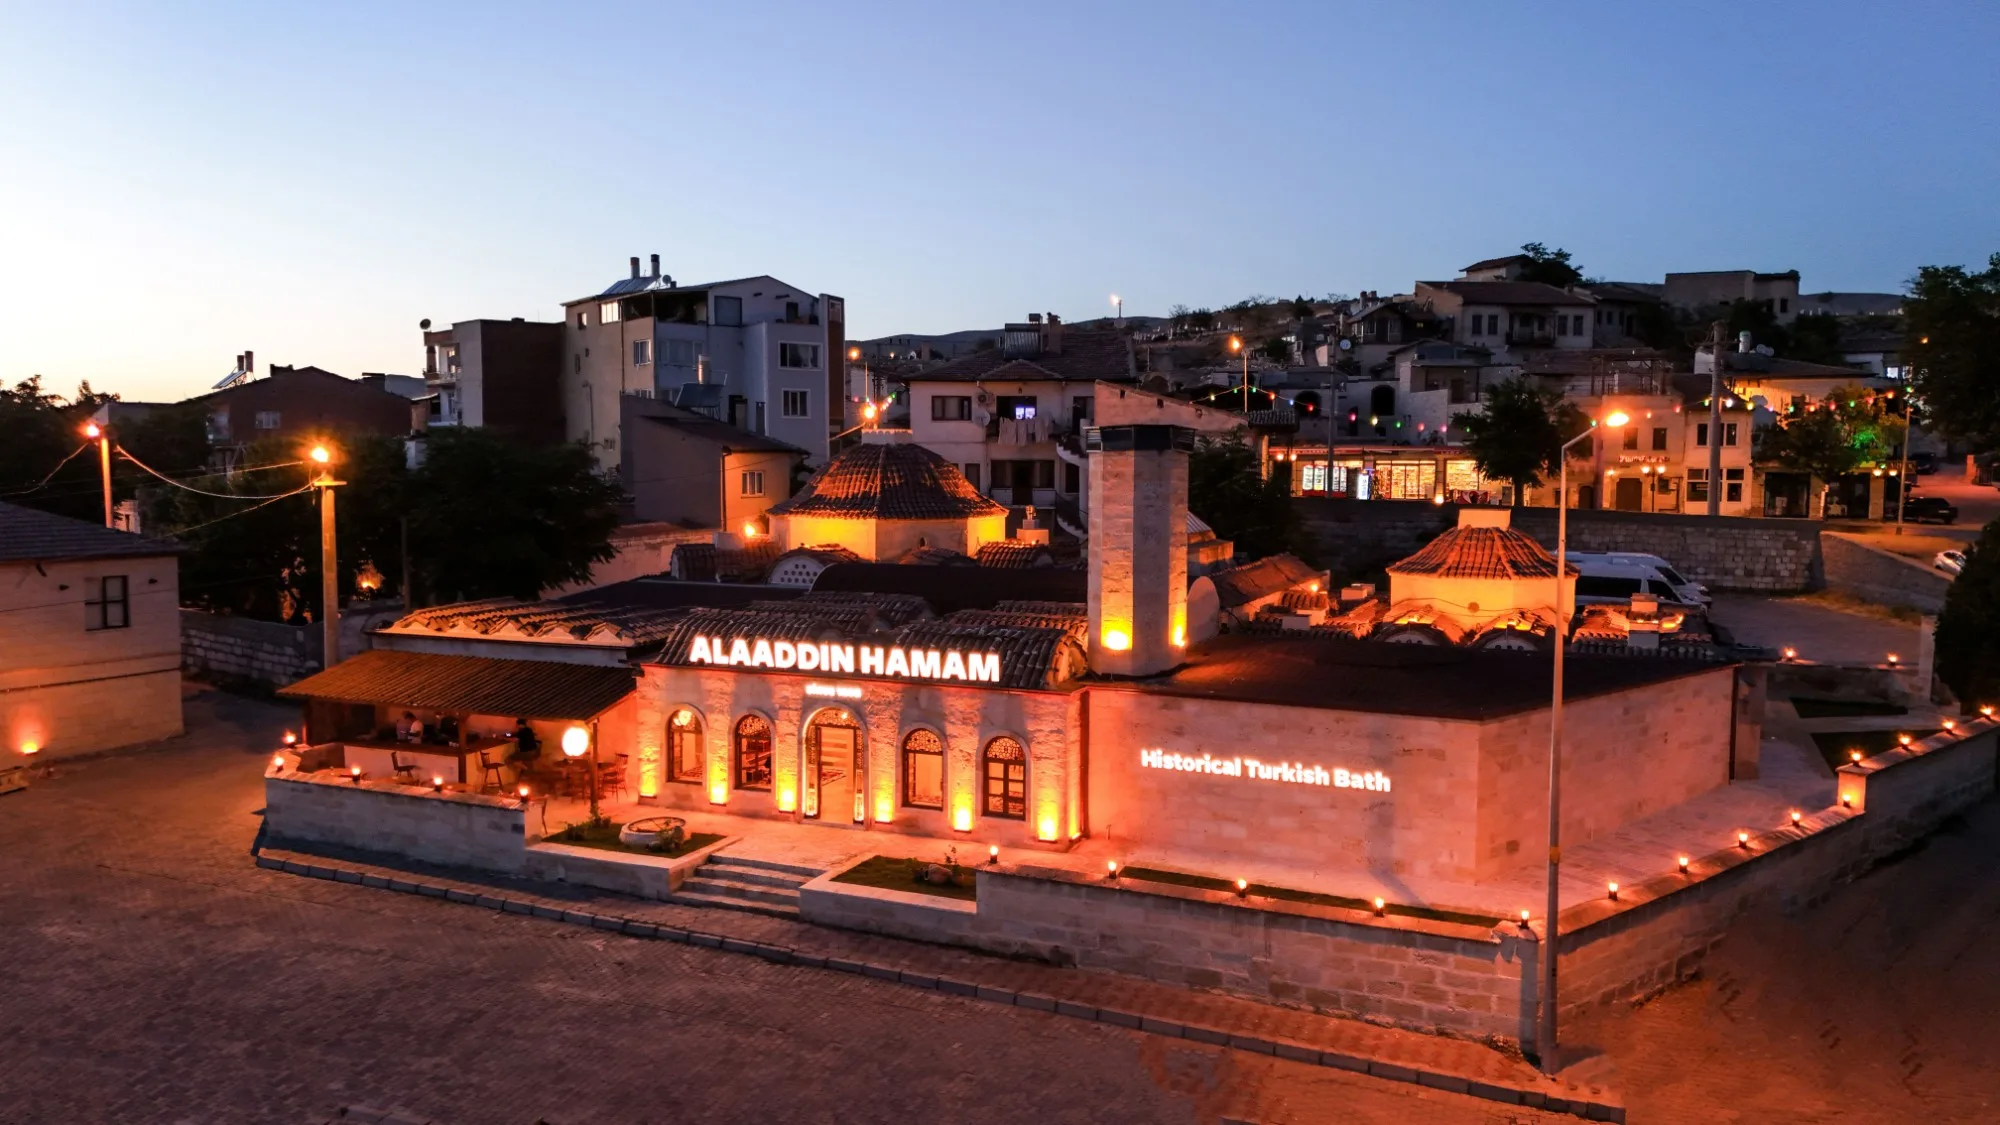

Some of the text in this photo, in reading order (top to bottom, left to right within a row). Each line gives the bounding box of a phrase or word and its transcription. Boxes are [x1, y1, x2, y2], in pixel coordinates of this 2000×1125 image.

[689, 636, 1000, 682] ALAADDIN HAMAM
[1140, 749, 1391, 792] Historical Turkish Bath
